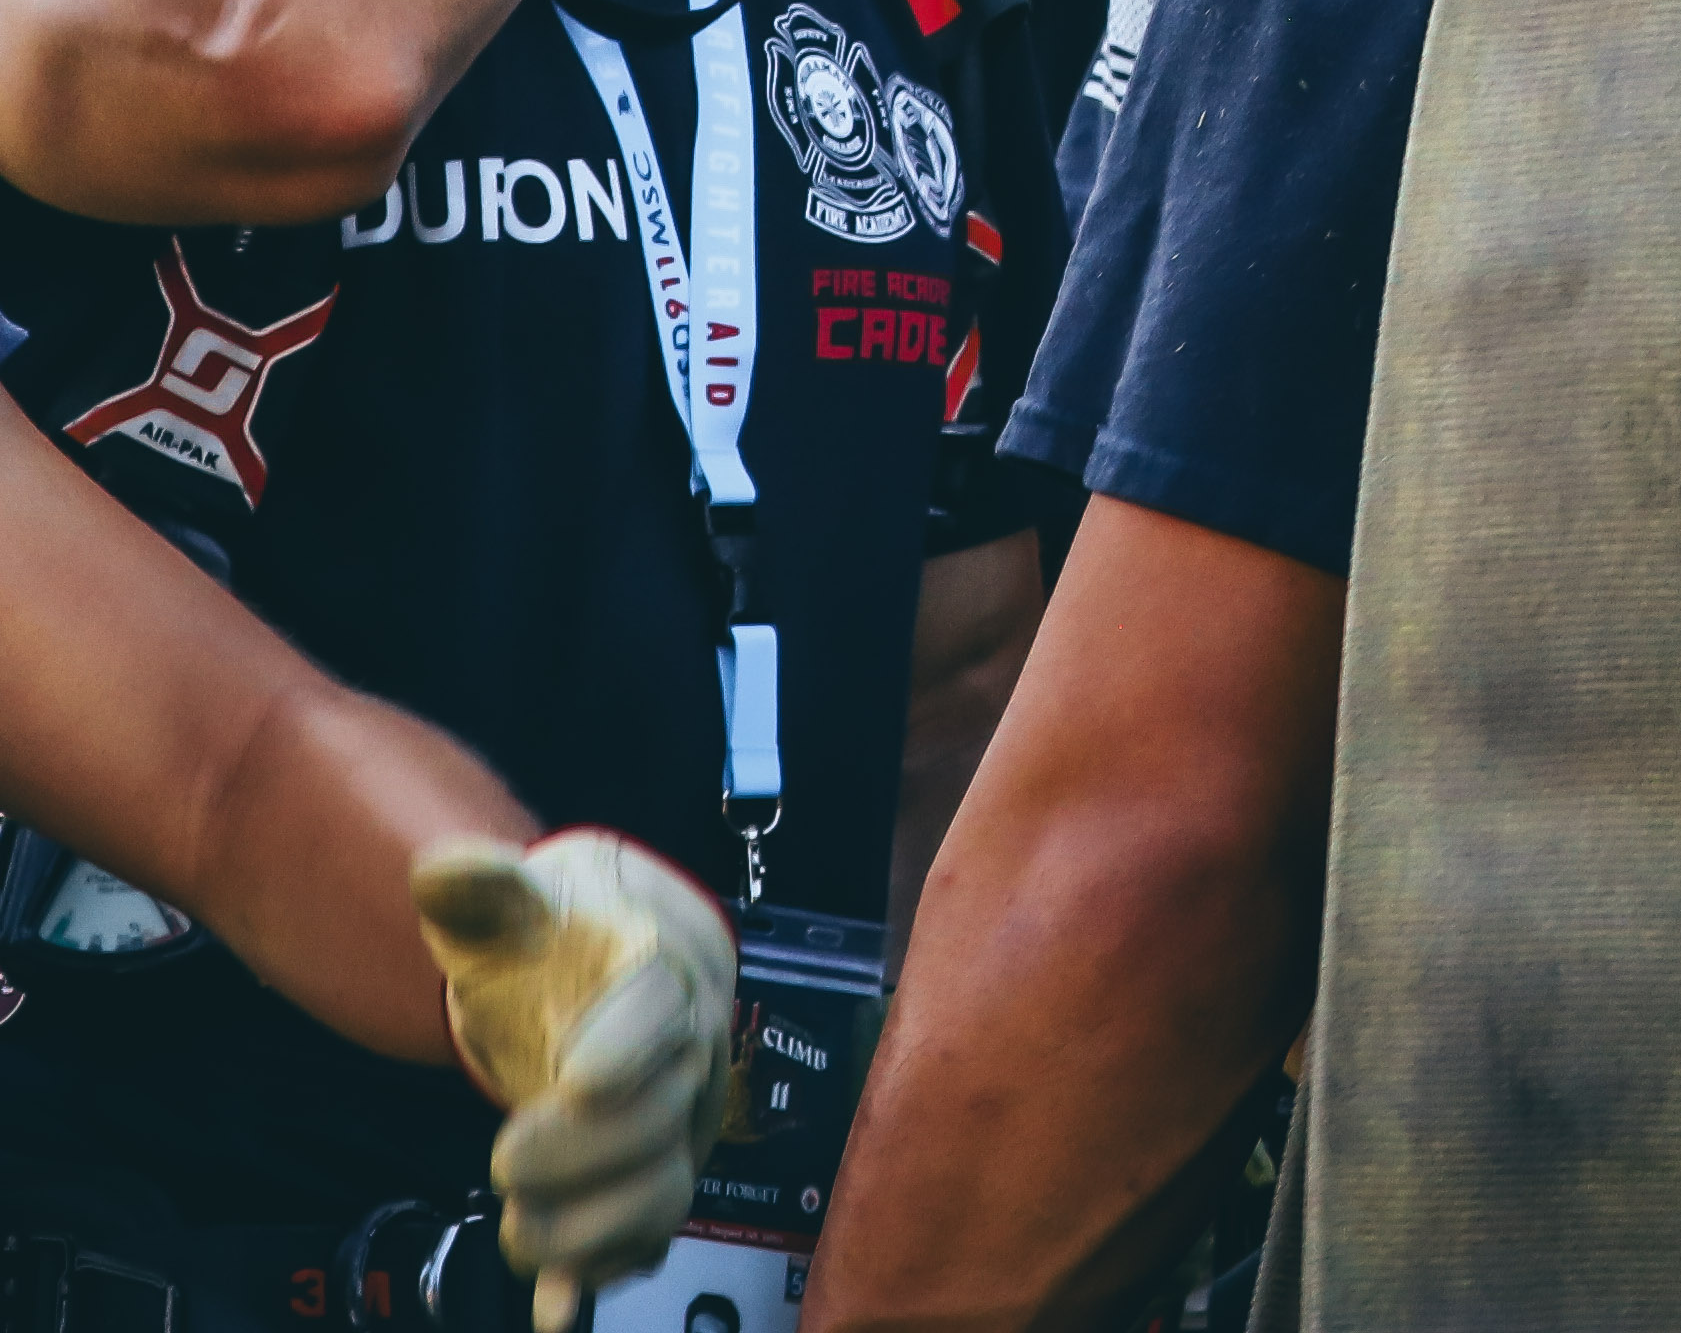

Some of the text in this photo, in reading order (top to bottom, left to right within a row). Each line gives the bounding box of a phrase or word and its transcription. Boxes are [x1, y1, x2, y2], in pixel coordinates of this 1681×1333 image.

[811, 267, 876, 298] FIRE
[815, 306, 949, 367] CADE
[705, 321, 741, 407] AID
[138, 421, 221, 470] AIR-PAK
[762, 1025, 828, 1072] CLIMB
